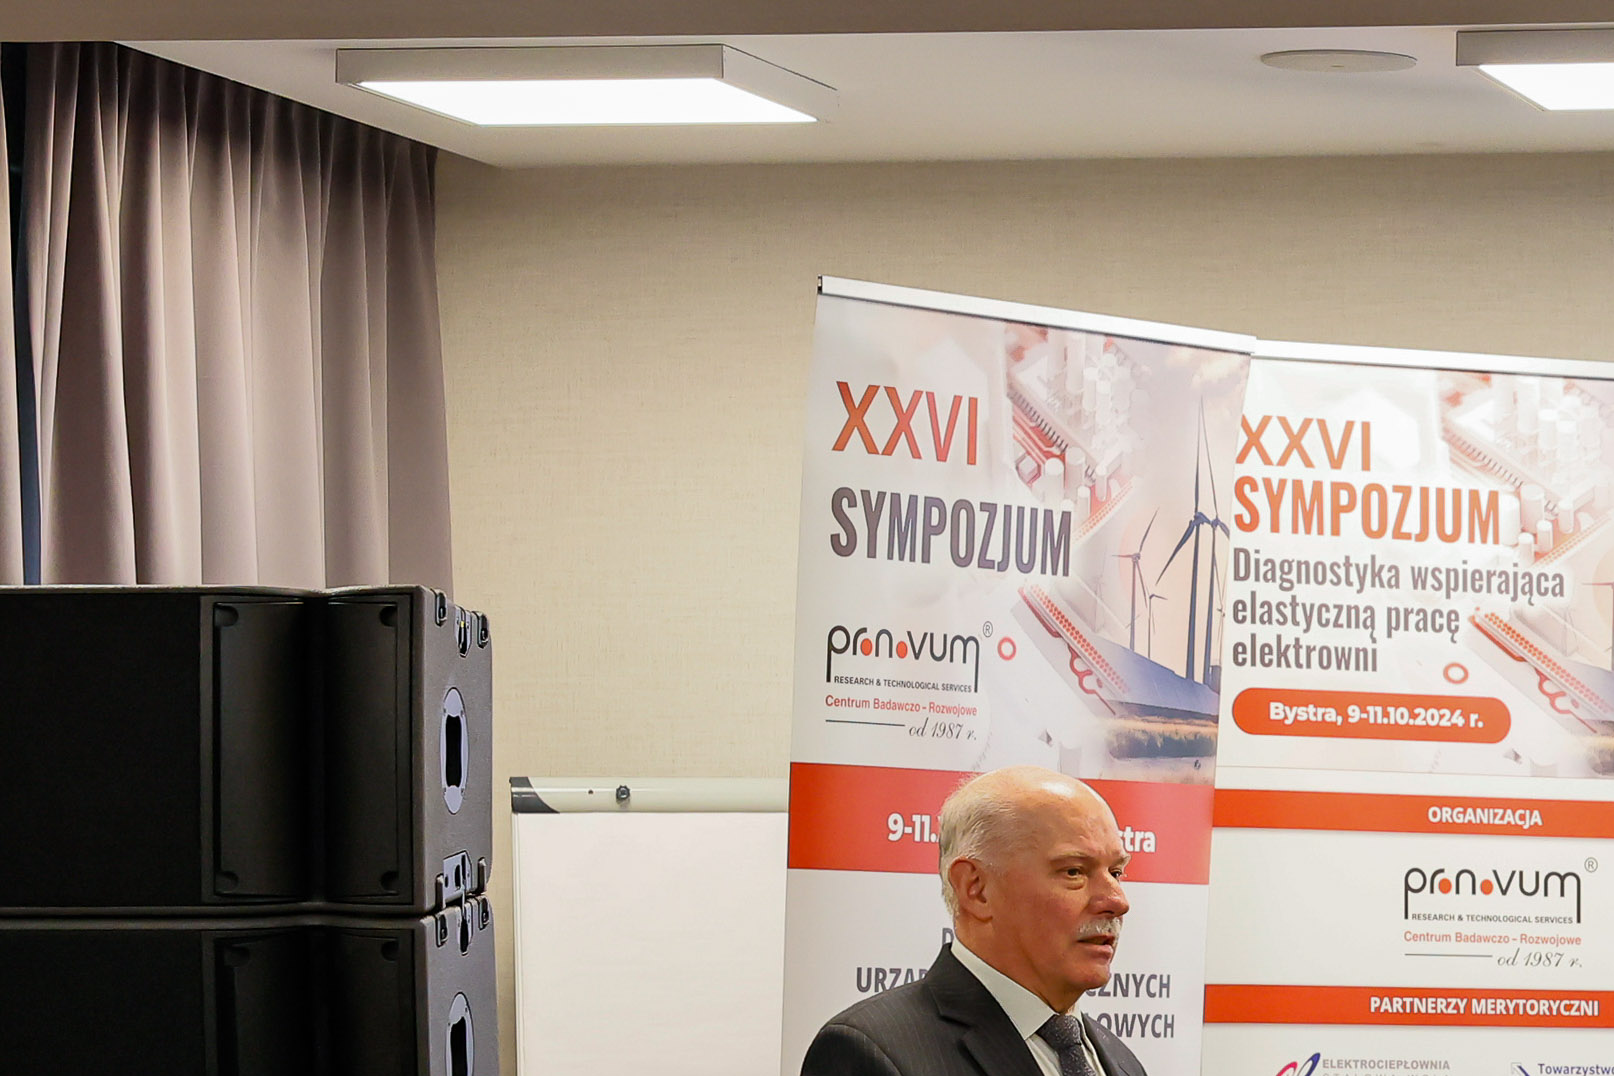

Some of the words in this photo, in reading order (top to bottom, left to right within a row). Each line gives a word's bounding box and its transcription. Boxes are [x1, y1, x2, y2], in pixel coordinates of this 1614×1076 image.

[832, 381, 978, 466] XXVI
[1235, 413, 1372, 471] XXVI
[1234, 475, 1500, 545] SYMPOZJUM
[830, 486, 1072, 578] SYMPOZJUM
[1233, 547, 1401, 594] Diagnostyka
[1410, 559, 1566, 606] wspierająca
[1233, 590, 1376, 642] elastyczną
[1387, 606, 1460, 644] pracę
[1232, 633, 1378, 672] elektrowni
[834, 675, 874, 686] RESEARCH
[884, 679, 939, 691] TECHNOLOGICAL
[941, 683, 972, 693] SERVICES
[825, 694, 870, 709] Centrum
[873, 698, 920, 712] Badawczo
[929, 702, 977, 716] Rozwojowe
[1269, 701, 1343, 726] Bystra,
[1348, 705, 1465, 728] 9-11.10.2024
[1469, 711, 1484, 728] r.
[909, 717, 929, 737] od
[932, 721, 964, 740] 1987
[967, 730, 977, 740] r.
[888, 812, 941, 842] 9-11.
[1427, 806, 1543, 829] ORGANIZACJA
[1411, 913, 1455, 922] RESEARCH
[1466, 914, 1532, 923] TECHNOLOGICAL
[1535, 916, 1573, 924] SERVICES
[1403, 931, 1452, 943] Centrum
[1455, 932, 1510, 944] Badawczo
[1520, 933, 1582, 948] Rozwojowe
[1497, 948, 1520, 967] od
[1524, 951, 1564, 968] 1987
[1370, 997, 1467, 1015] PARTNERZY
[1471, 998, 1600, 1017] MERYTORYCZNI
[1322, 1059, 1450, 1070] ELEKTROCIEPŁOWNIA
